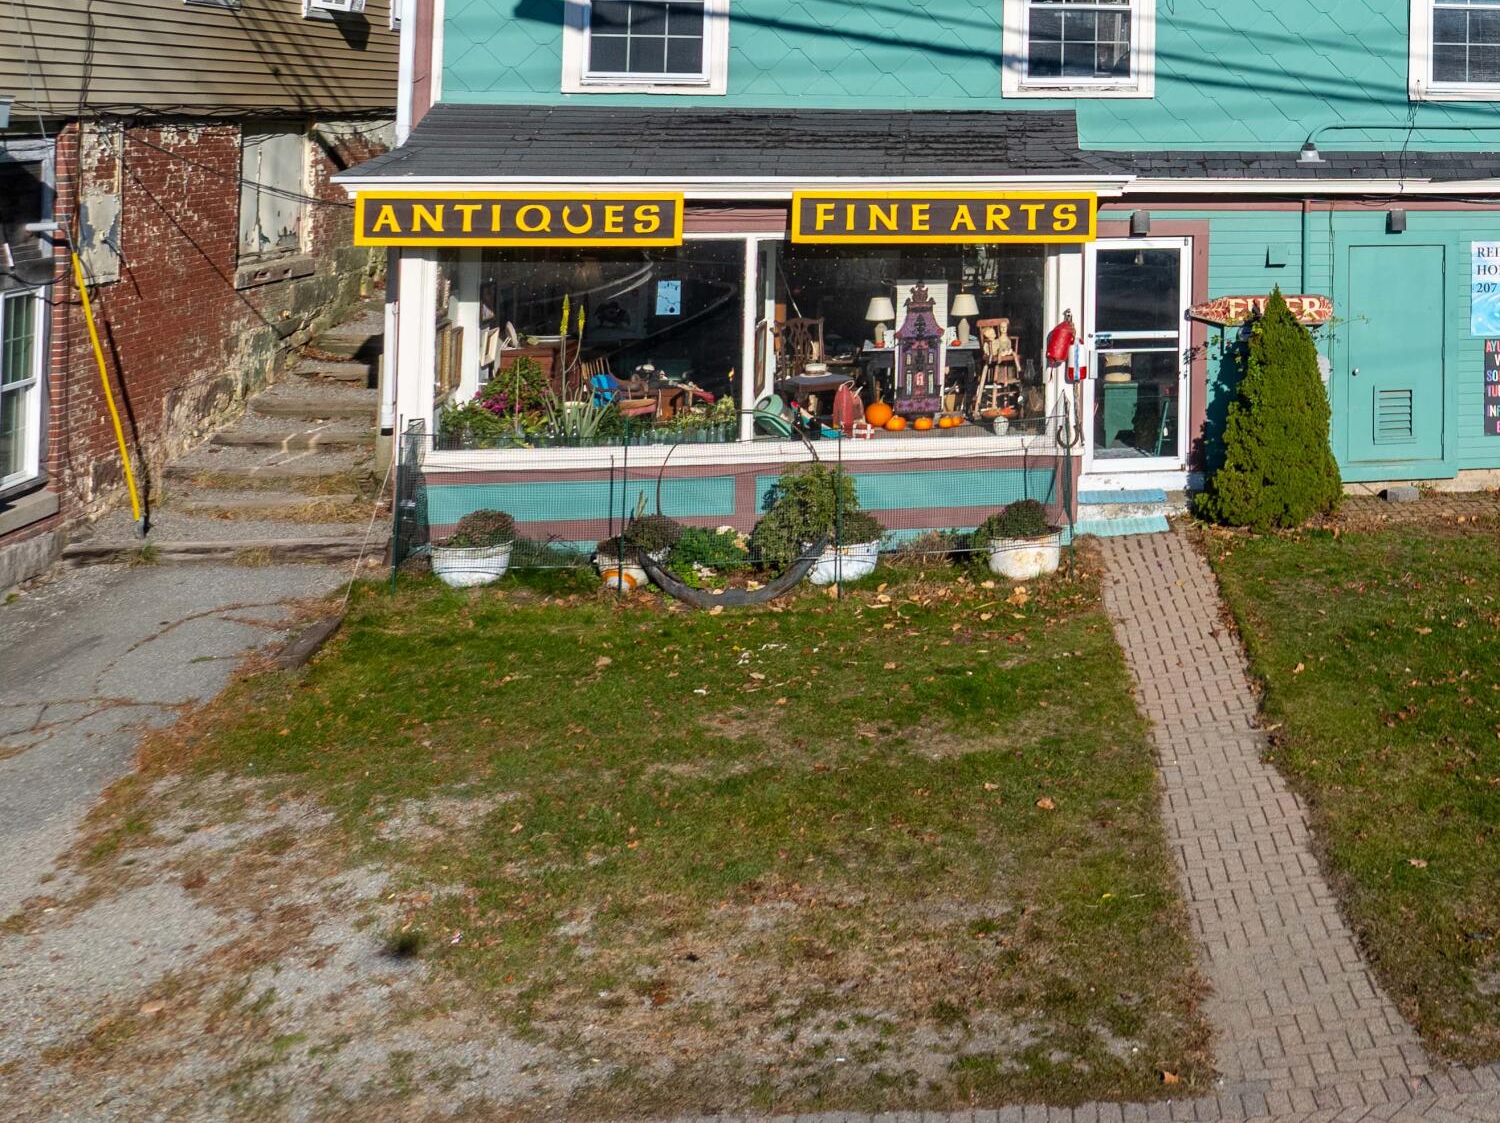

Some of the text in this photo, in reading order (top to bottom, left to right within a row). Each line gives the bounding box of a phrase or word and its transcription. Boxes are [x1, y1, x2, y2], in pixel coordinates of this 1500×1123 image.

[372, 204, 661, 234] ANTIQUES
[815, 203, 1078, 232] FINE ARTS
[1476, 282, 1497, 293] 207
